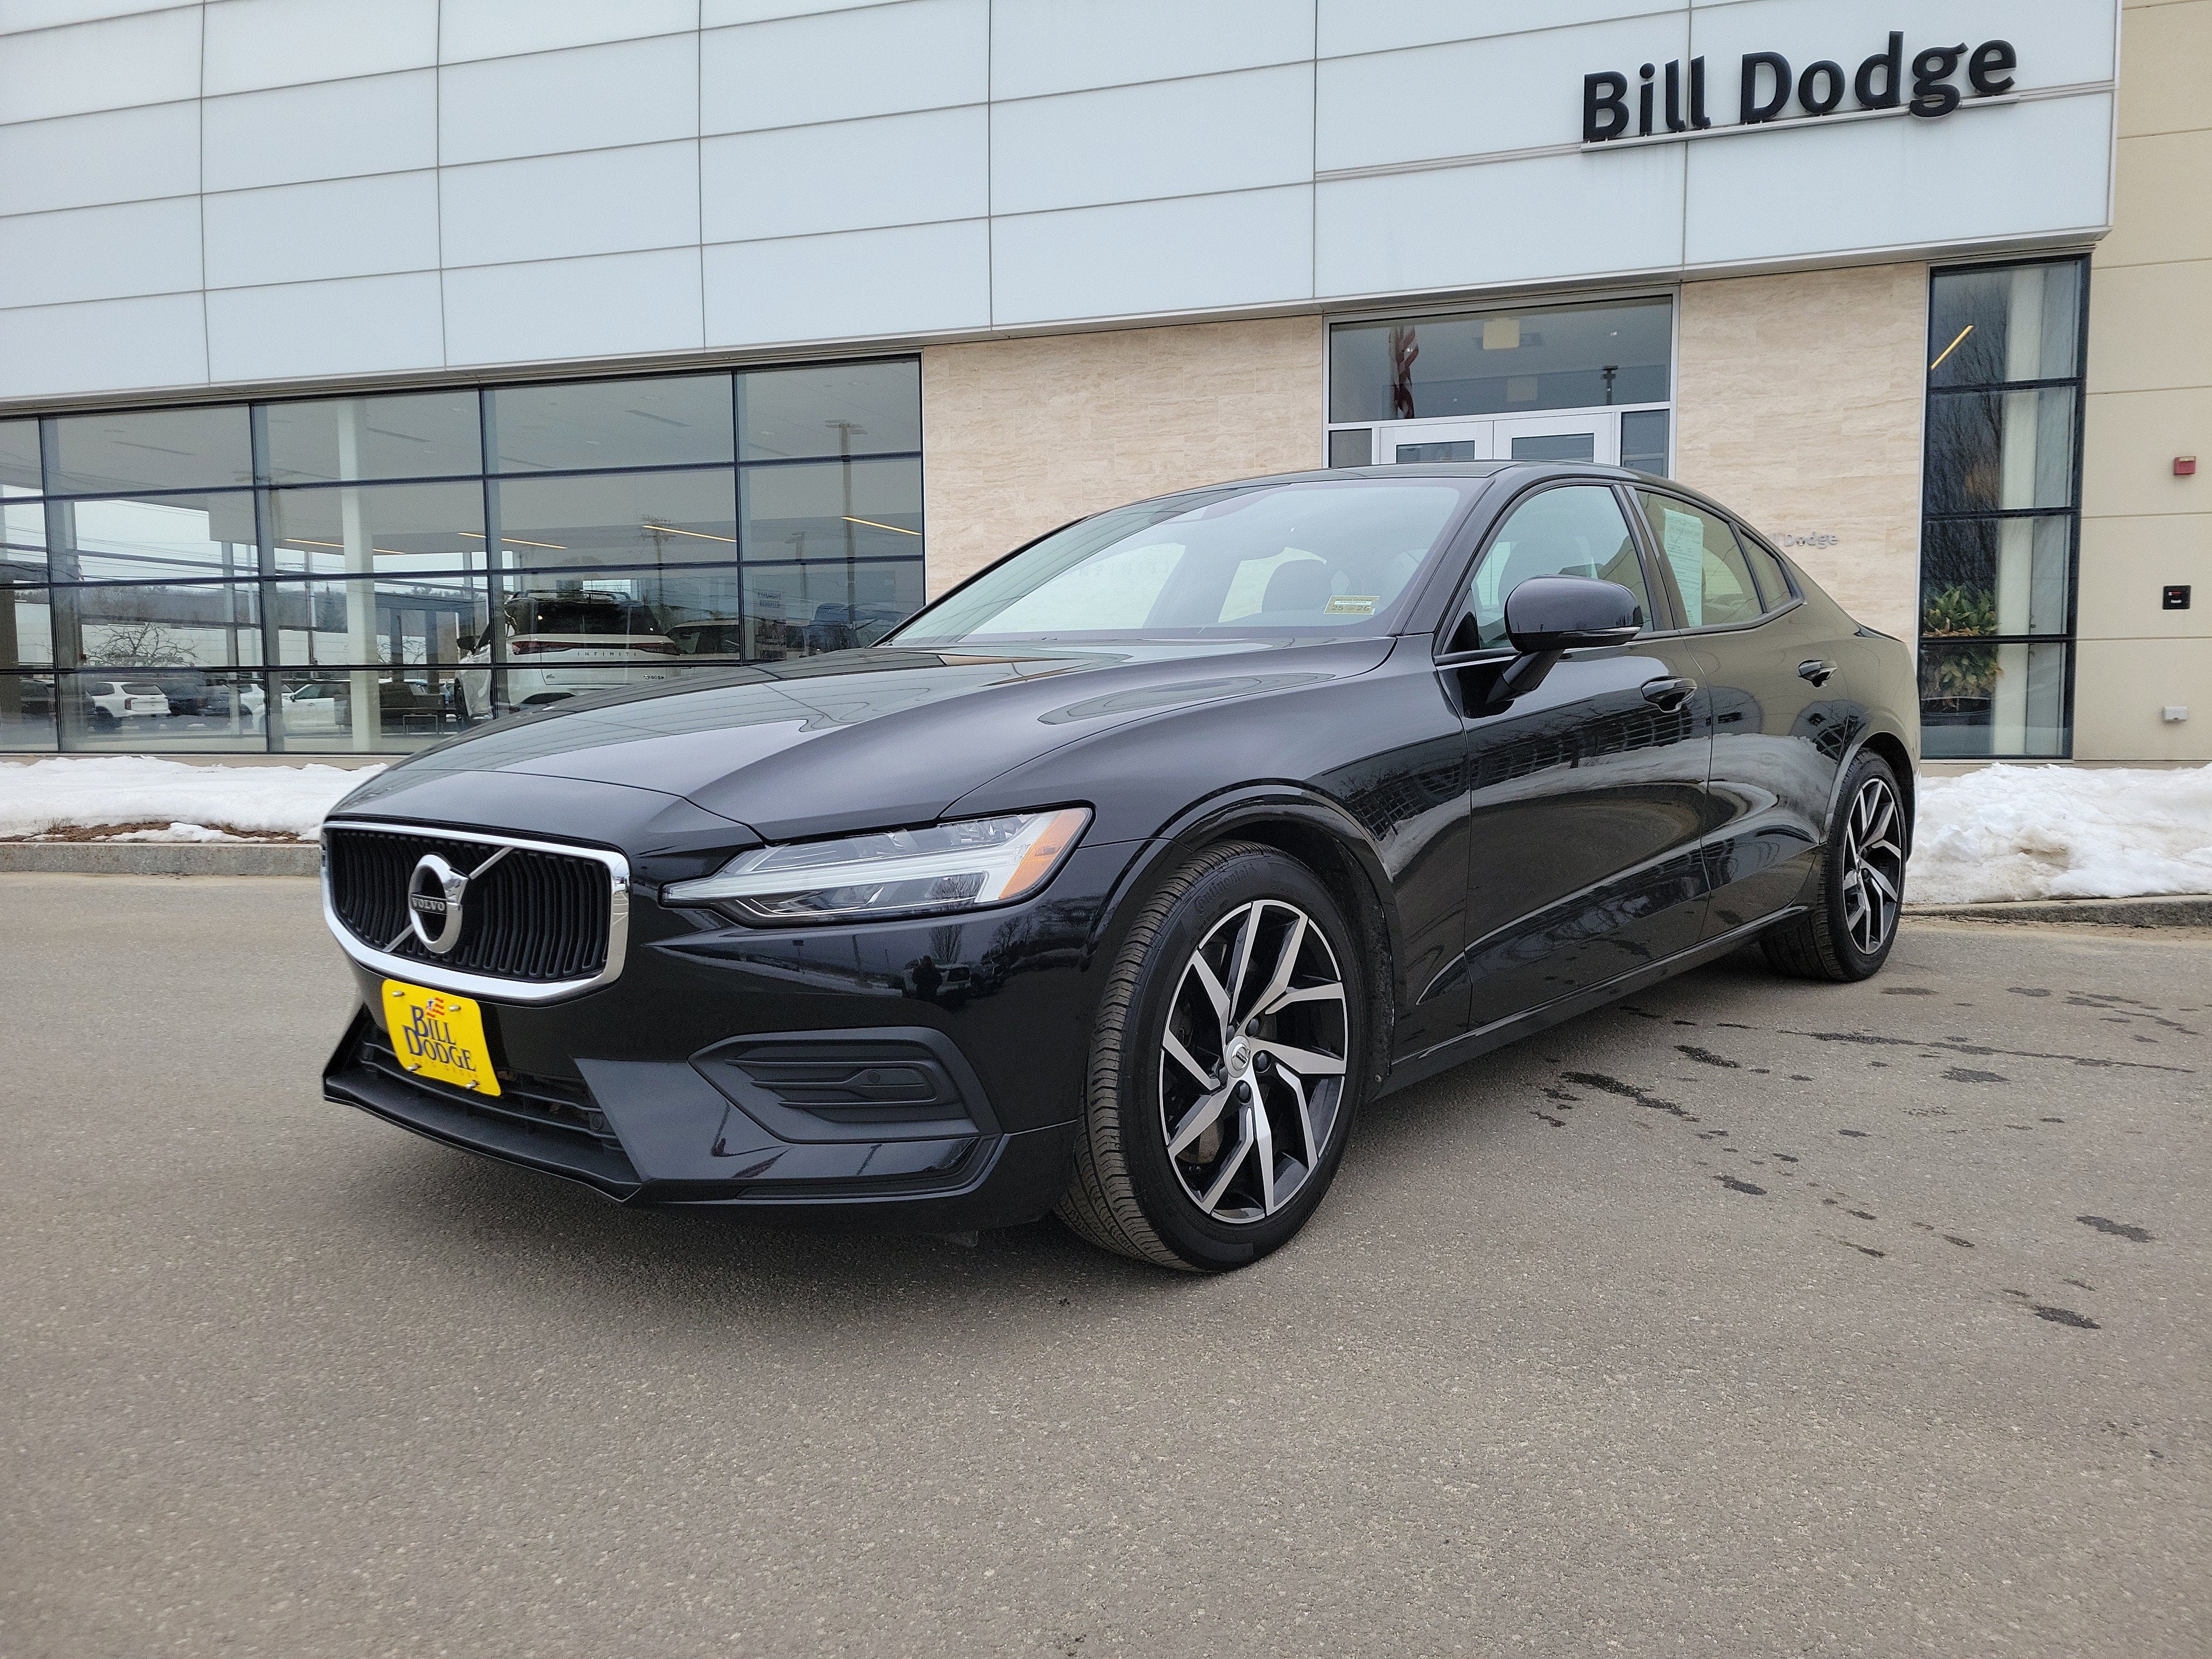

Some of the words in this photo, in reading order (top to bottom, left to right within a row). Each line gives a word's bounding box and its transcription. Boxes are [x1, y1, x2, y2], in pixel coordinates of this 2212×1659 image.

[1583, 55, 1711, 142] Bill
[1740, 30, 2016, 123] Dodge
[1784, 531, 1838, 549] Dodge
[411, 897, 446, 911] VOLVO
[410, 1005, 456, 1046] BILL
[402, 1024, 476, 1072] DODGE
